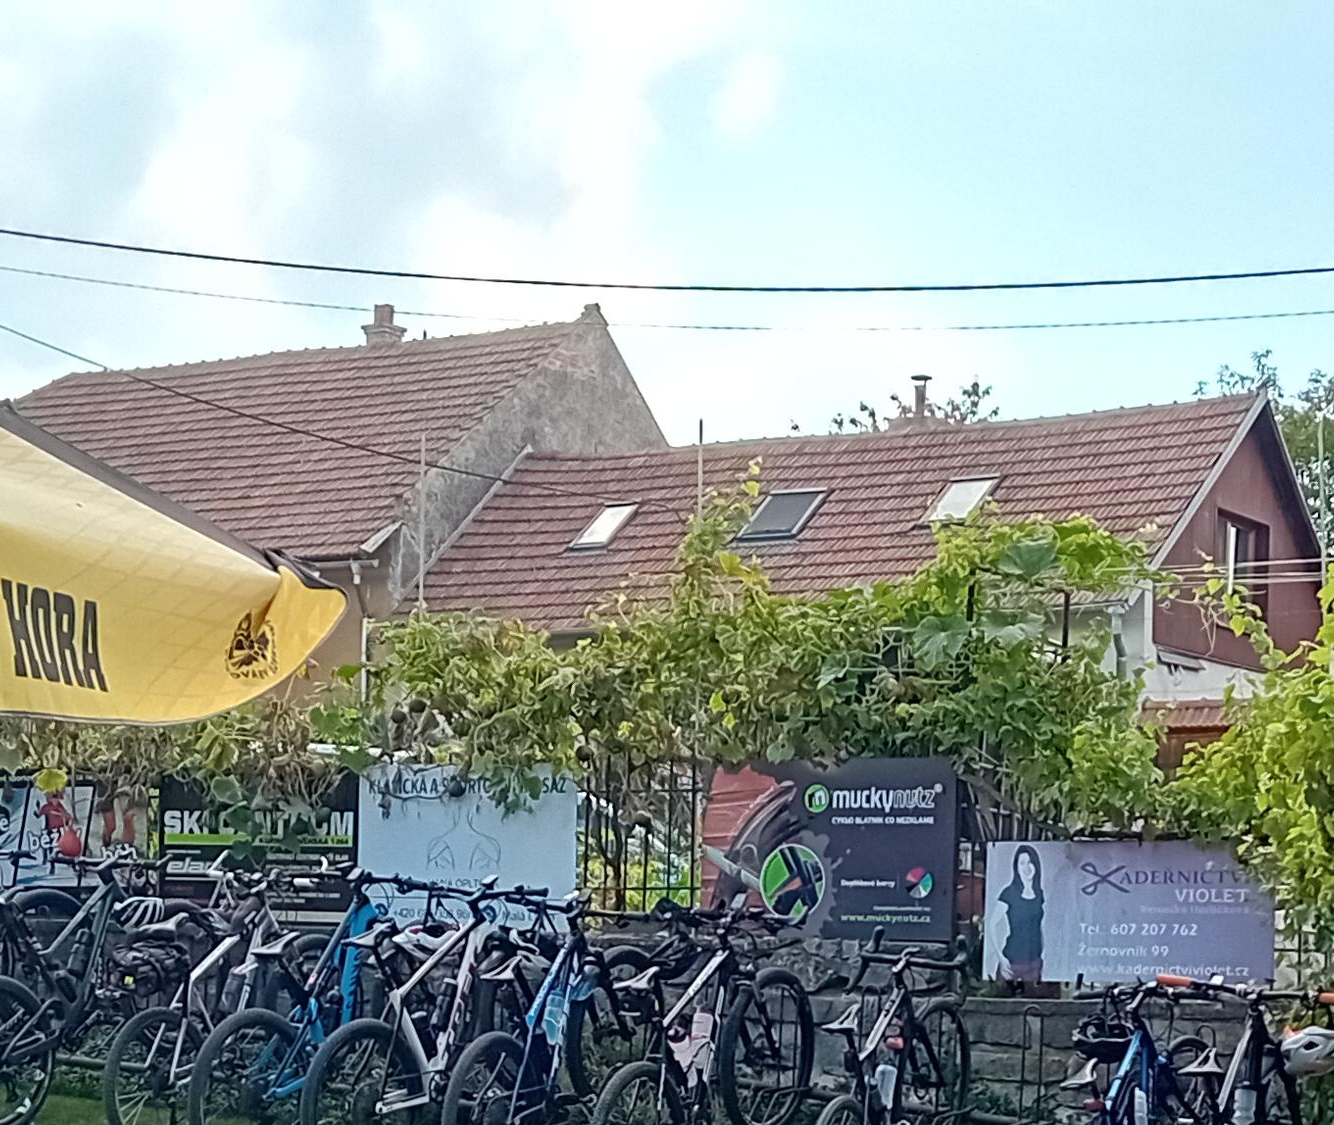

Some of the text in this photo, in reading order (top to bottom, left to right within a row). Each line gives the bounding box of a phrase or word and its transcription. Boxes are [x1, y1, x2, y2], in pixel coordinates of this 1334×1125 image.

[1, 577, 109, 692] HORA
[831, 816, 854, 825] CYKLO
[884, 816, 895, 825] CO
[896, 816, 935, 825] NEZKLAME
[29, 826, 82, 850] běž
[1175, 888, 1251, 903] VIOLET
[841, 914, 932, 926] www.muckynutz.cz
[1110, 923, 1137, 936] 607
[1141, 923, 1167, 936] 207
[1172, 923, 1198, 936] 762
[1151, 945, 1169, 957] 99
